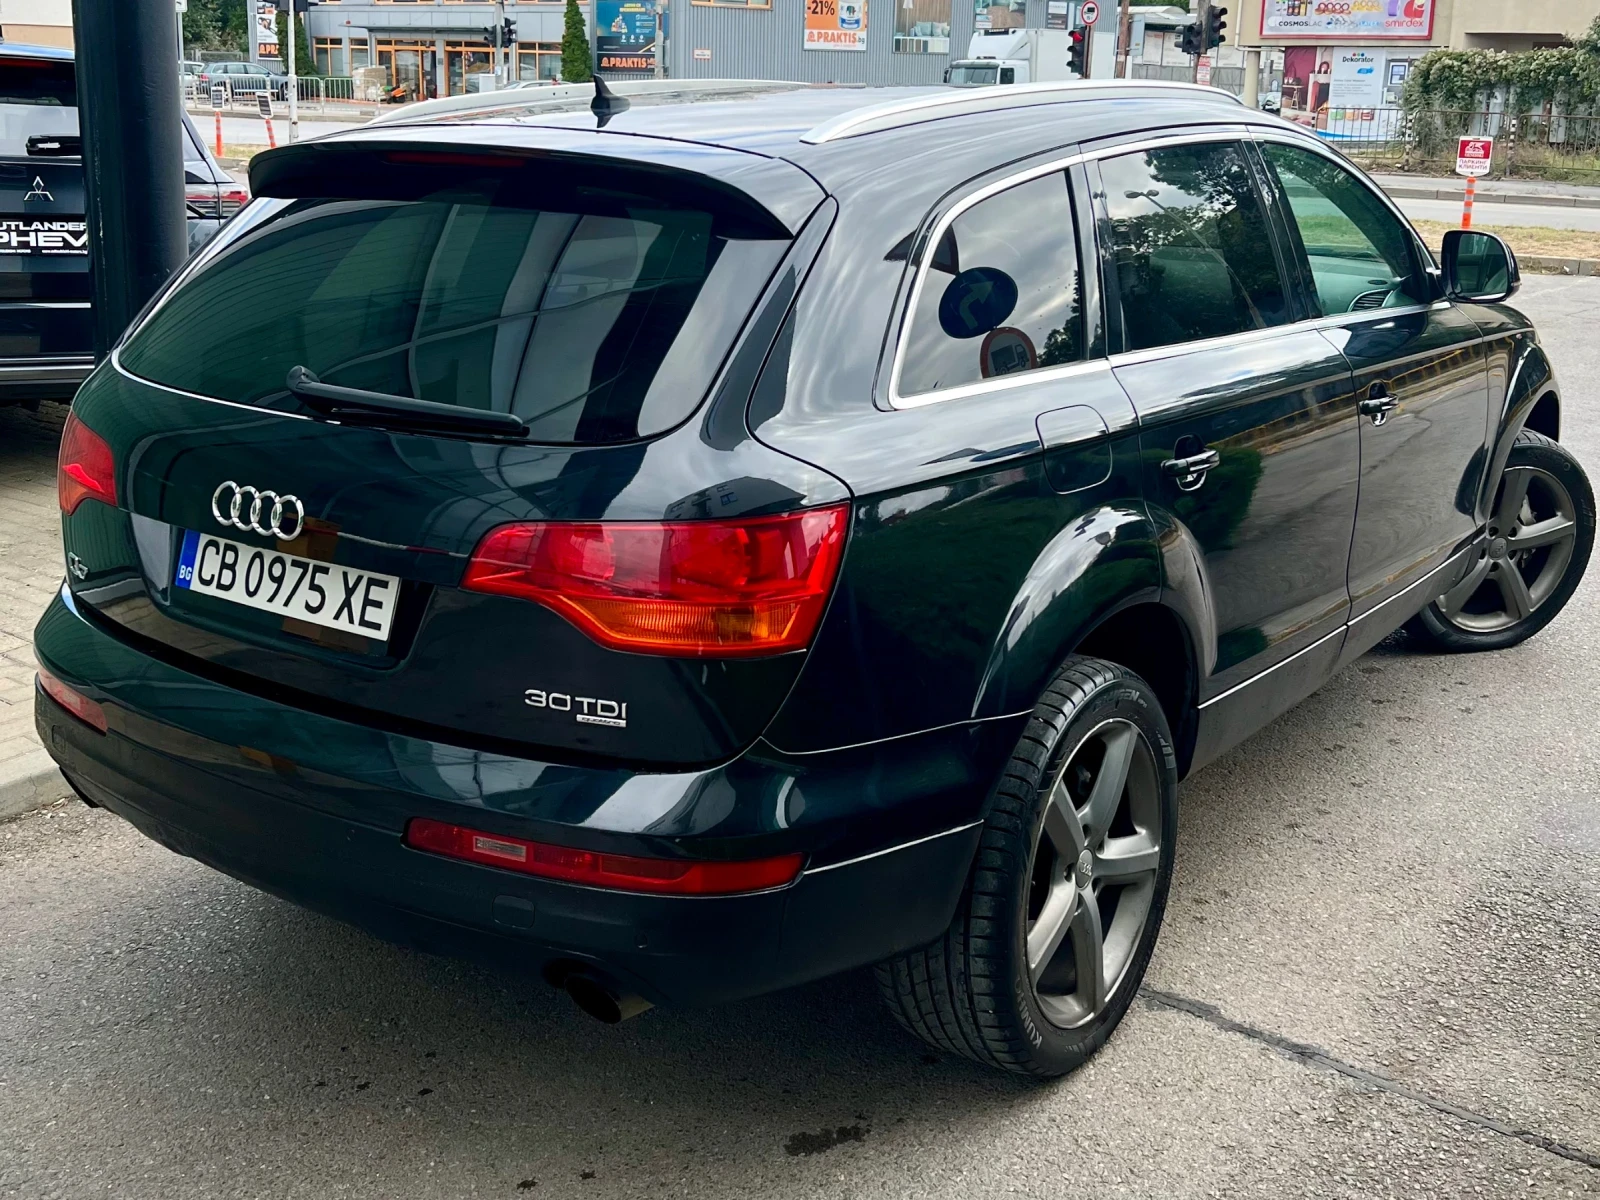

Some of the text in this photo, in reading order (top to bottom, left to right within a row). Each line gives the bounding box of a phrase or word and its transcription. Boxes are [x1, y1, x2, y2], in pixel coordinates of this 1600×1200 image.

[807, 0, 835, 15] -21%
[1385, 18, 1424, 28] smirdex
[610, 57, 647, 68] PRAKTIS
[179, 564, 193, 581] BG
[197, 539, 390, 632] CB 0975 XE
[575, 696, 628, 719] TDI
